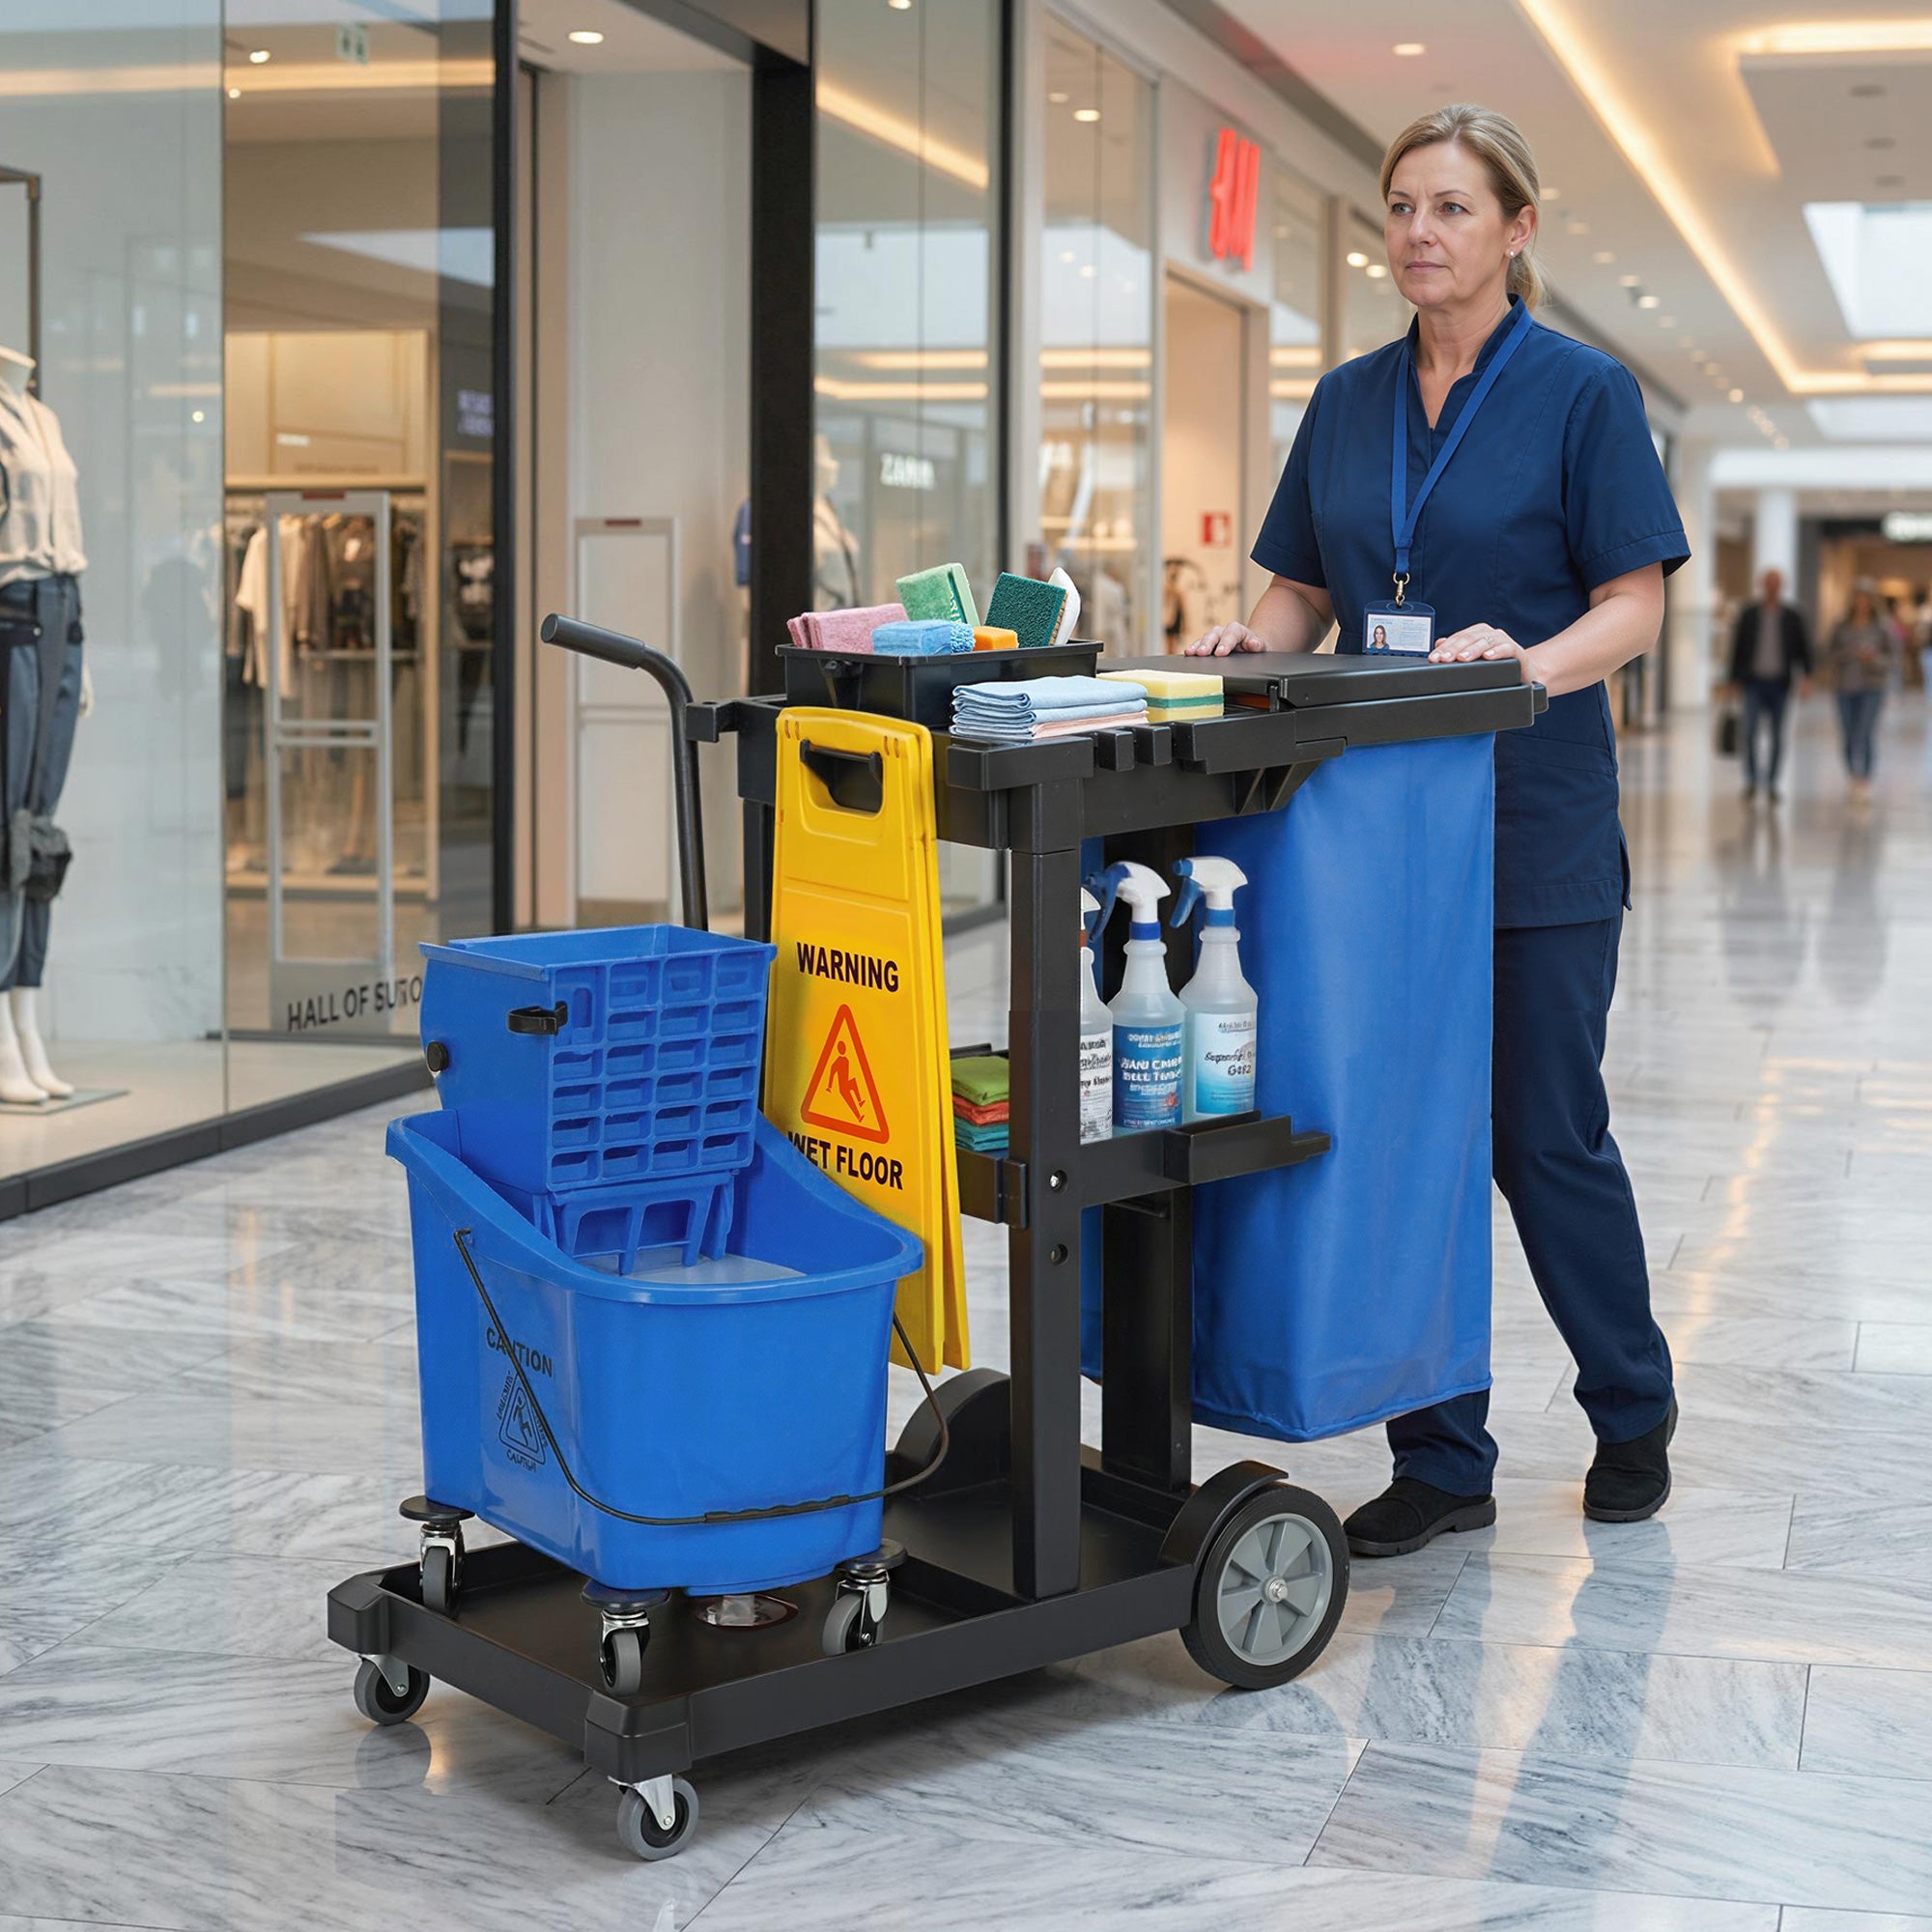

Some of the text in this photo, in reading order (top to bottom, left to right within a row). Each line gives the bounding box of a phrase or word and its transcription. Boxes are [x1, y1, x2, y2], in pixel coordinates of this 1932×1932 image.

[796, 942, 899, 993] WARNING
[288, 993, 340, 1032] HALL
[343, 984, 369, 1018] OF
[787, 1131, 903, 1190] WET FLOOR
